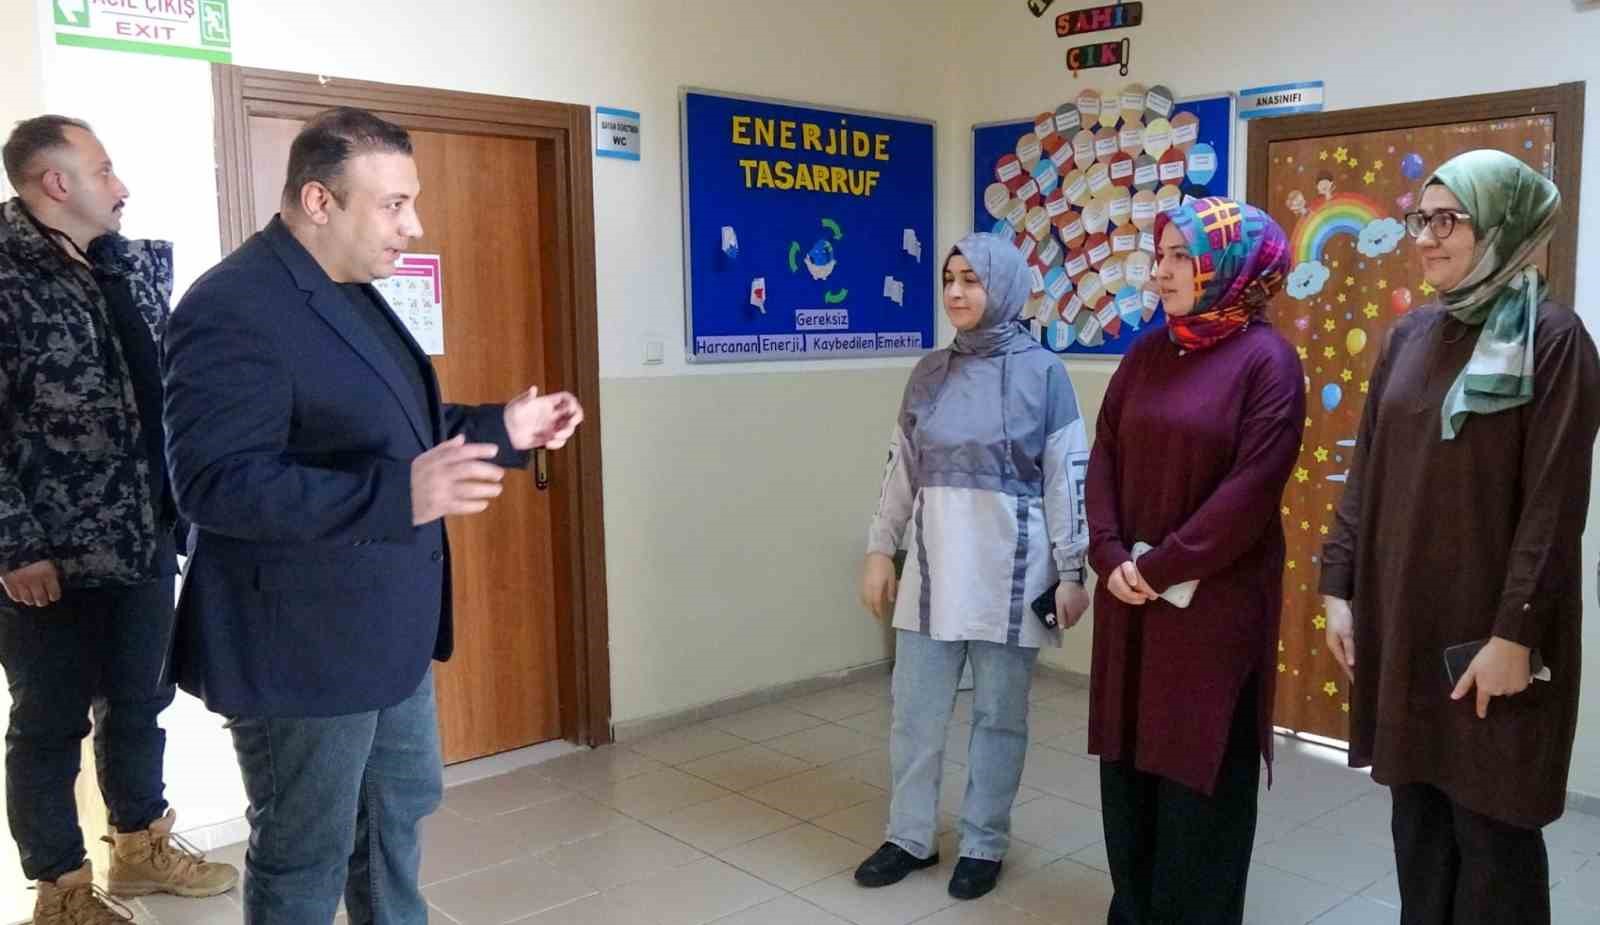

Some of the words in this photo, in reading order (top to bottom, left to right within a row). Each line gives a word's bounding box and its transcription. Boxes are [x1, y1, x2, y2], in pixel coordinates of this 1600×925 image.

[116, 22, 176, 40] EXIT
[612, 135, 627, 146] WC
[732, 115, 890, 161] ENERJİDE
[739, 159, 880, 196] TASARRUF
[796, 313, 848, 326] Gereksiz
[696, 340, 758, 353] Harcanan
[813, 336, 875, 352] Kaybedilen
